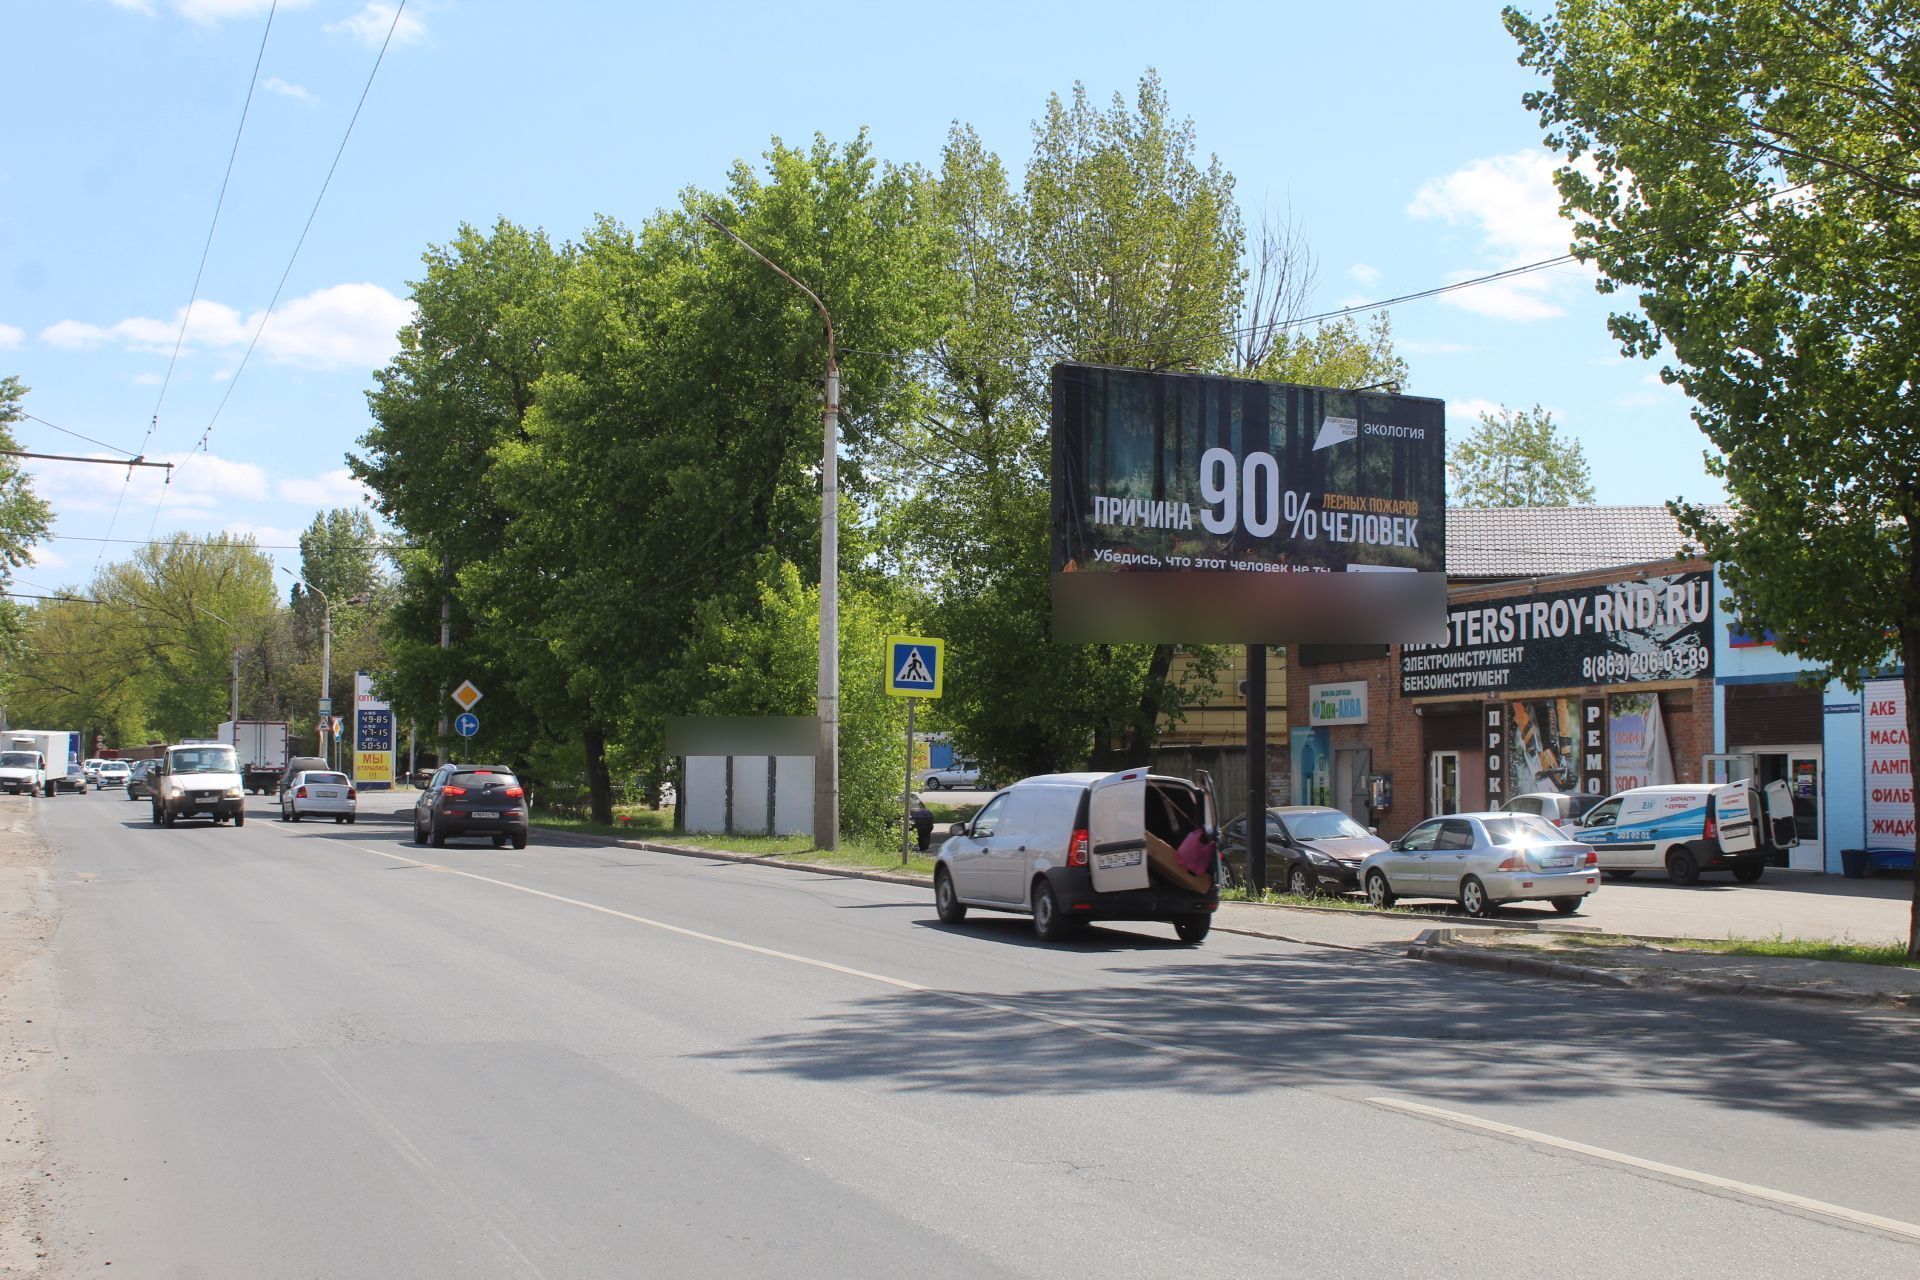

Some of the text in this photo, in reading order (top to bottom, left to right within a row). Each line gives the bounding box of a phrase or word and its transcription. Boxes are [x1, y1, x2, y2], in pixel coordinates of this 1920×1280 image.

[1363, 423, 1425, 440] ЭКОЛОГИЯ
[1322, 493, 1419, 516] ЛЕСНЫХ ПОЖАРОВ
[1093, 496, 1193, 531] ПРИЧИНА
[1321, 511, 1420, 549] ЧЕЛОВЕК
[1093, 548, 1162, 568] Убедись,
[1165, 555, 1191, 567] что
[1194, 557, 1227, 570] этот
[1230, 560, 1289, 573] человек
[1403, 580, 1710, 652] TERSTROY-RND.RU
[1403, 646, 1525, 672] ЭЛЕКТРОИНСТРУМЕНТ
[1582, 646, 1710, 683] 8(863)206-03-89
[1403, 669, 1511, 692] БЕНЗОИНСТРУМЕНТ
[1869, 700, 1897, 716] АКБ
[362, 753, 384, 764] МЫ
